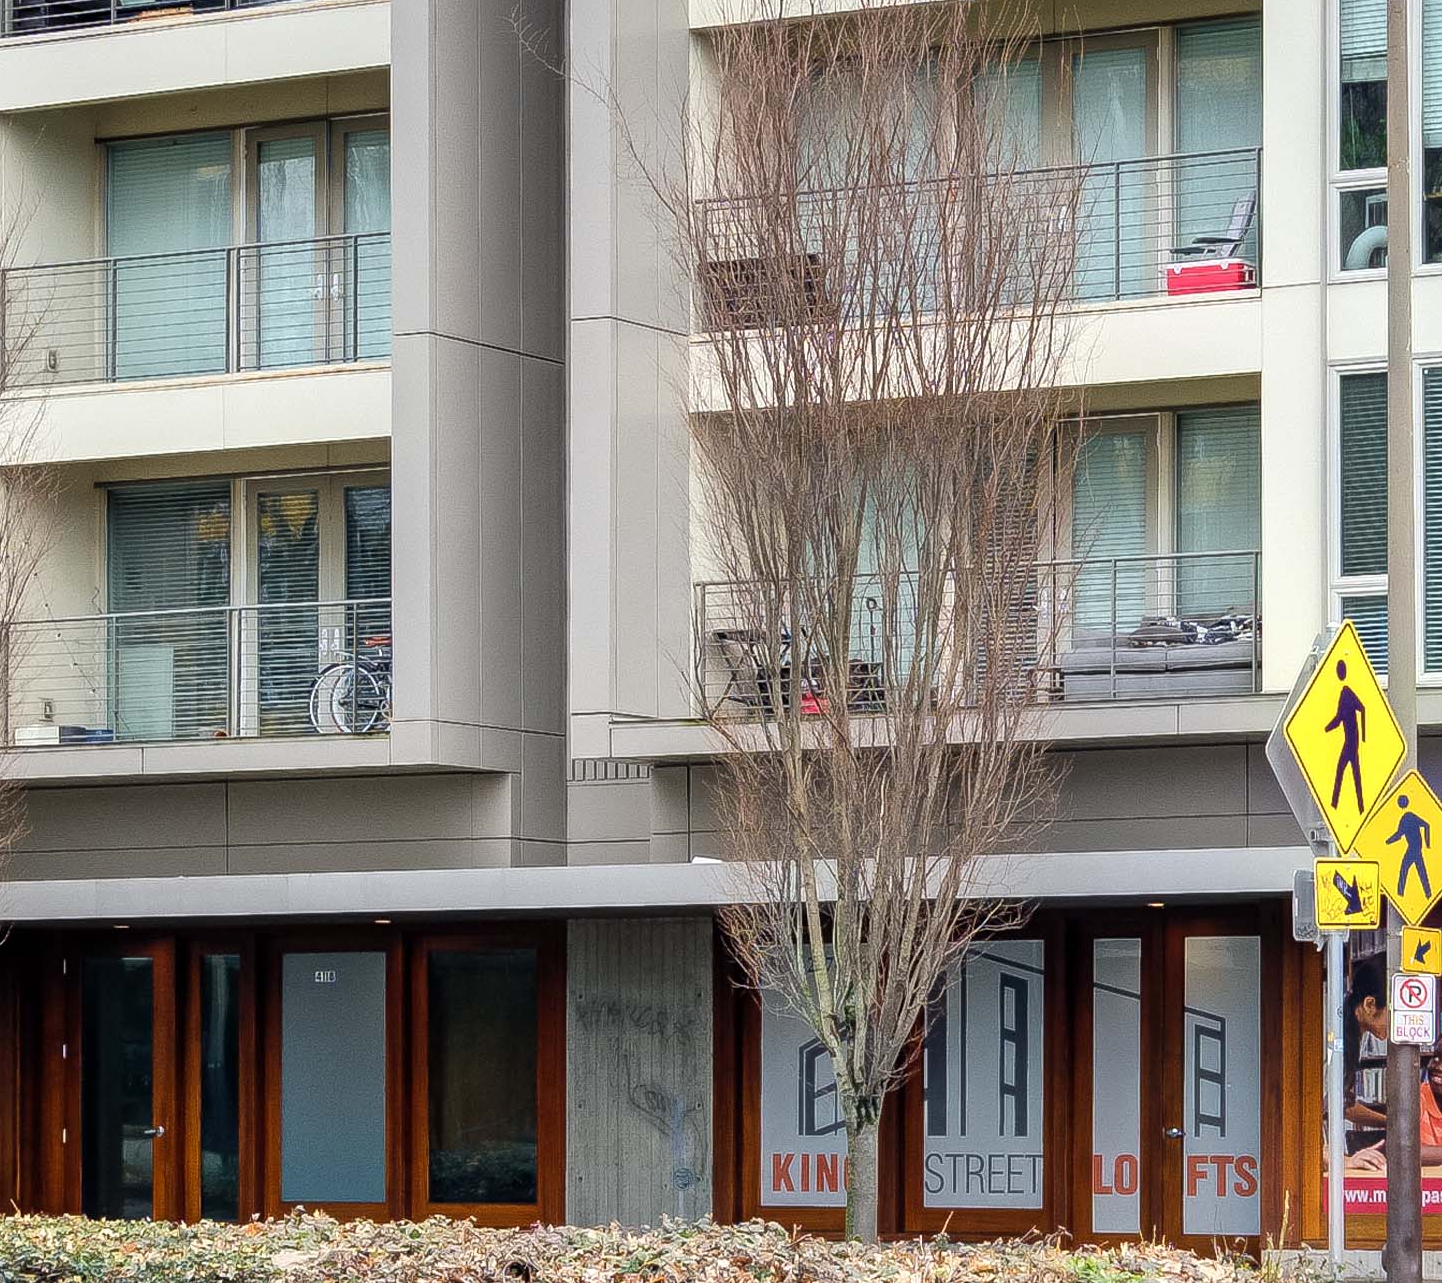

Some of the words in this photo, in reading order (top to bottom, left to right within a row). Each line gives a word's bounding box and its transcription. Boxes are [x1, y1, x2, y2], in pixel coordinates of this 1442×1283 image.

[1402, 1015, 1425, 1026] THIS
[1396, 1026, 1431, 1039] BLOCK
[772, 1153, 849, 1193] KIN
[924, 1153, 1043, 1194] STREET
